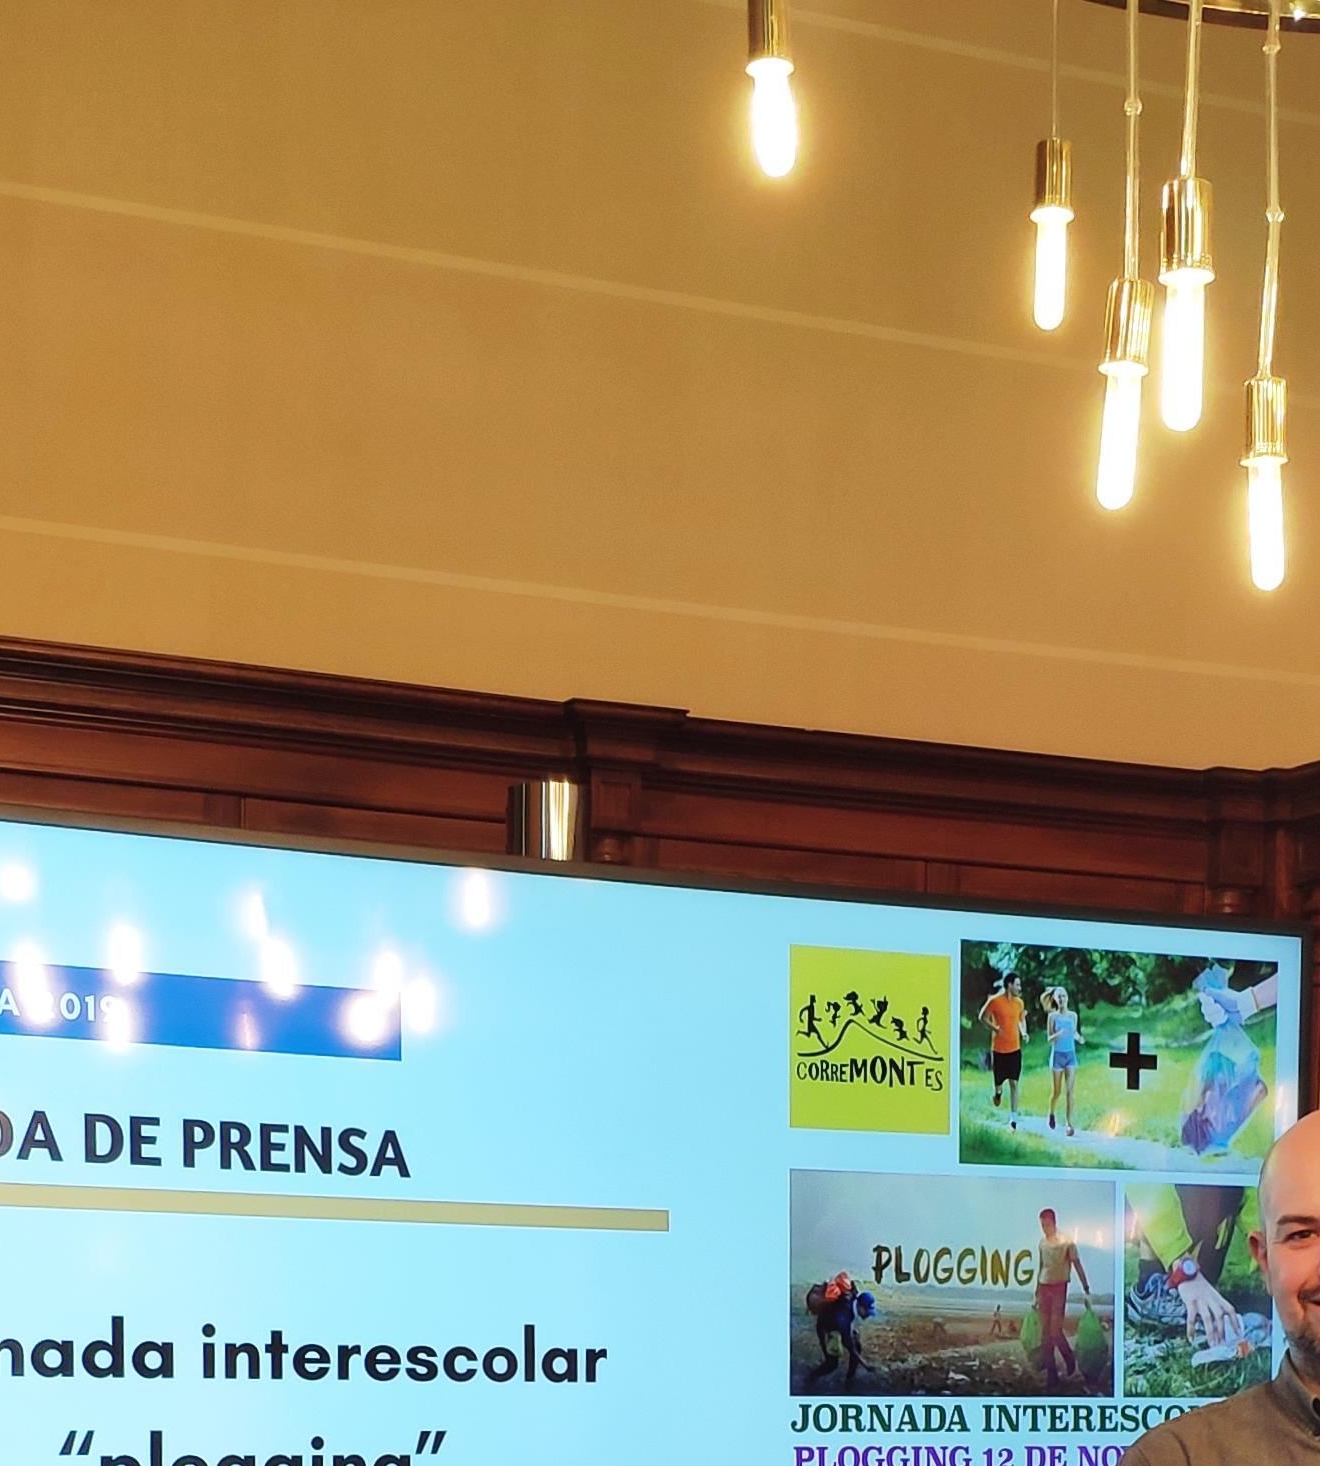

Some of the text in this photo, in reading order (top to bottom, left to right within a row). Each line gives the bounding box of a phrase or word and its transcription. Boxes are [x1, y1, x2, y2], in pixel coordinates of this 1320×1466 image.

[33, 992, 125, 1024] 019
[84, 1112, 161, 1167] DE
[183, 1119, 411, 1180] PRENSA
[872, 1245, 1035, 1287] PLOGGING
[202, 1323, 608, 1385] interescolar
[790, 1403, 1200, 1434] JORNADA INTERESCO
